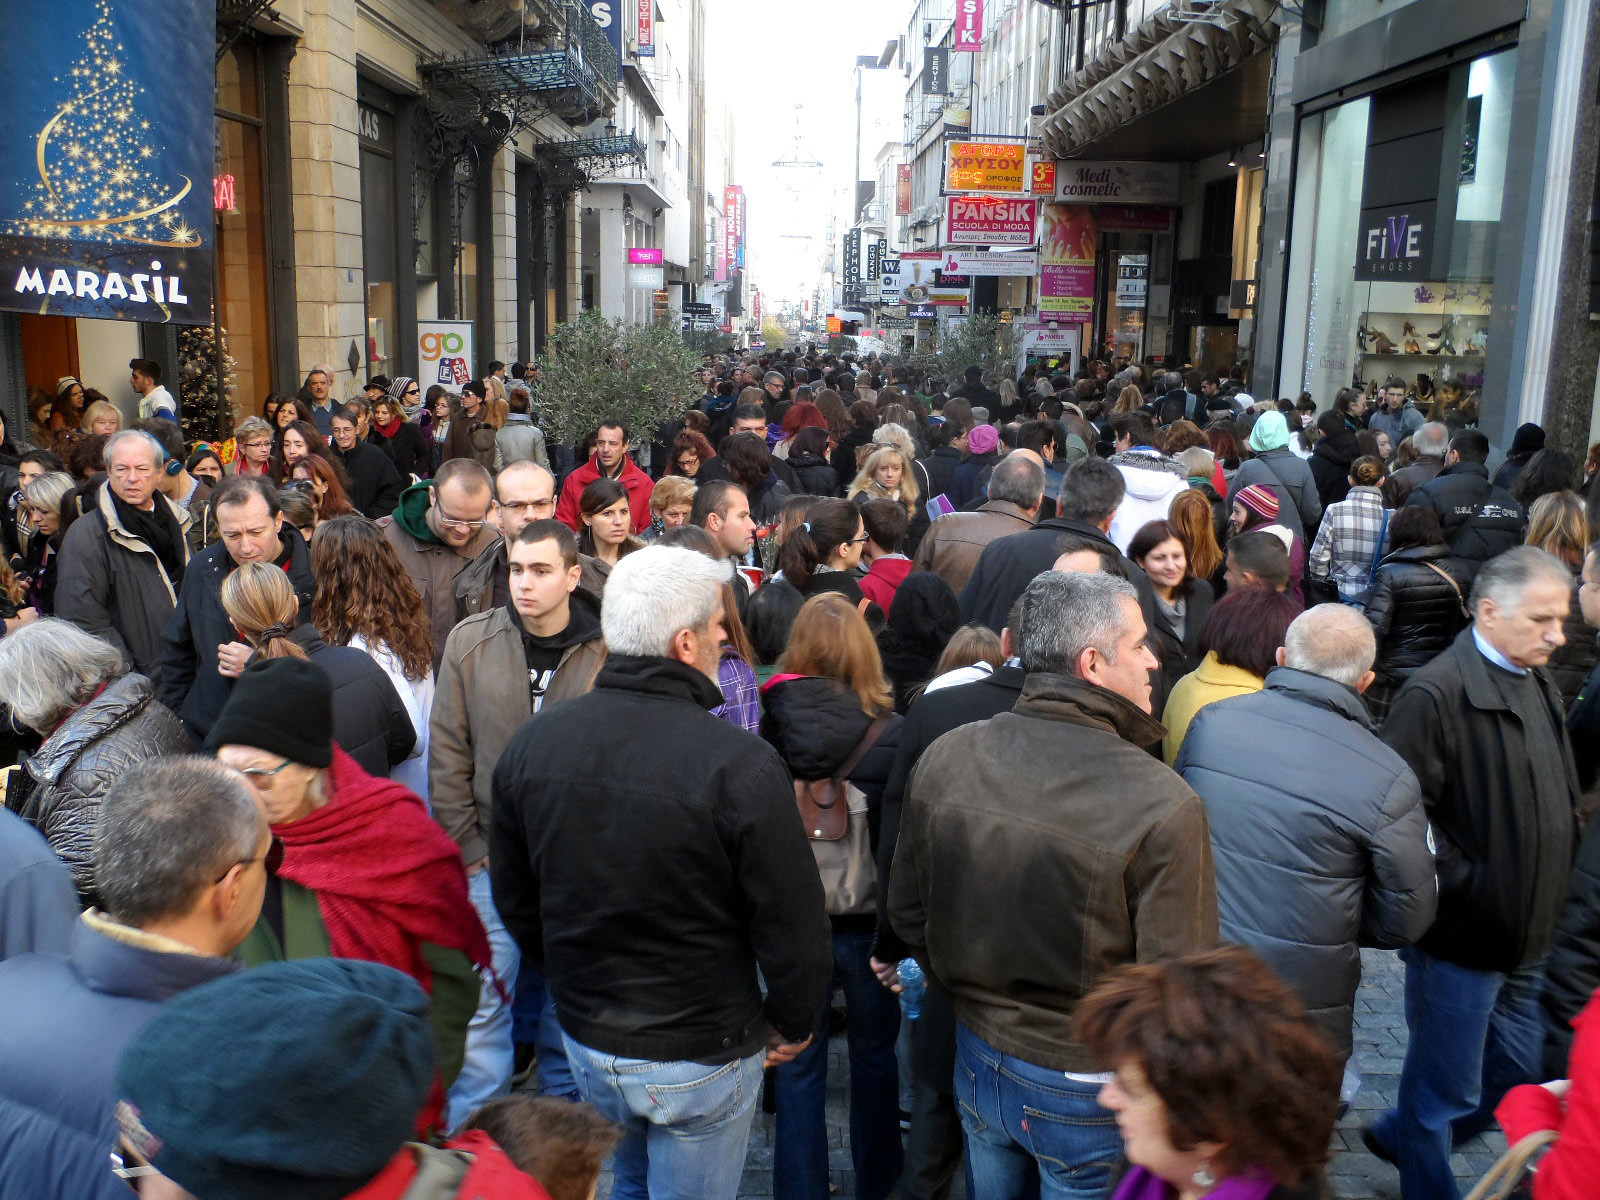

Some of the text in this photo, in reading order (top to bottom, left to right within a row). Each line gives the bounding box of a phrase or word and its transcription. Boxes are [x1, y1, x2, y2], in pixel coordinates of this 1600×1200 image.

[958, 144, 1017, 157] ΑΓΟΡΑ
[950, 157, 1022, 170] ΧΡΥΣΟΥ
[986, 175, 1022, 183] ΟΡΟΦΟΣ
[1076, 168, 1111, 183] Medi
[1063, 183, 1121, 197] cosmetic
[952, 222, 990, 230] SCUOLA
[1003, 223, 1030, 231] MODA
[637, 252, 654, 260] fresh
[1372, 261, 1412, 272] SHOES
[420, 333, 464, 361] go
